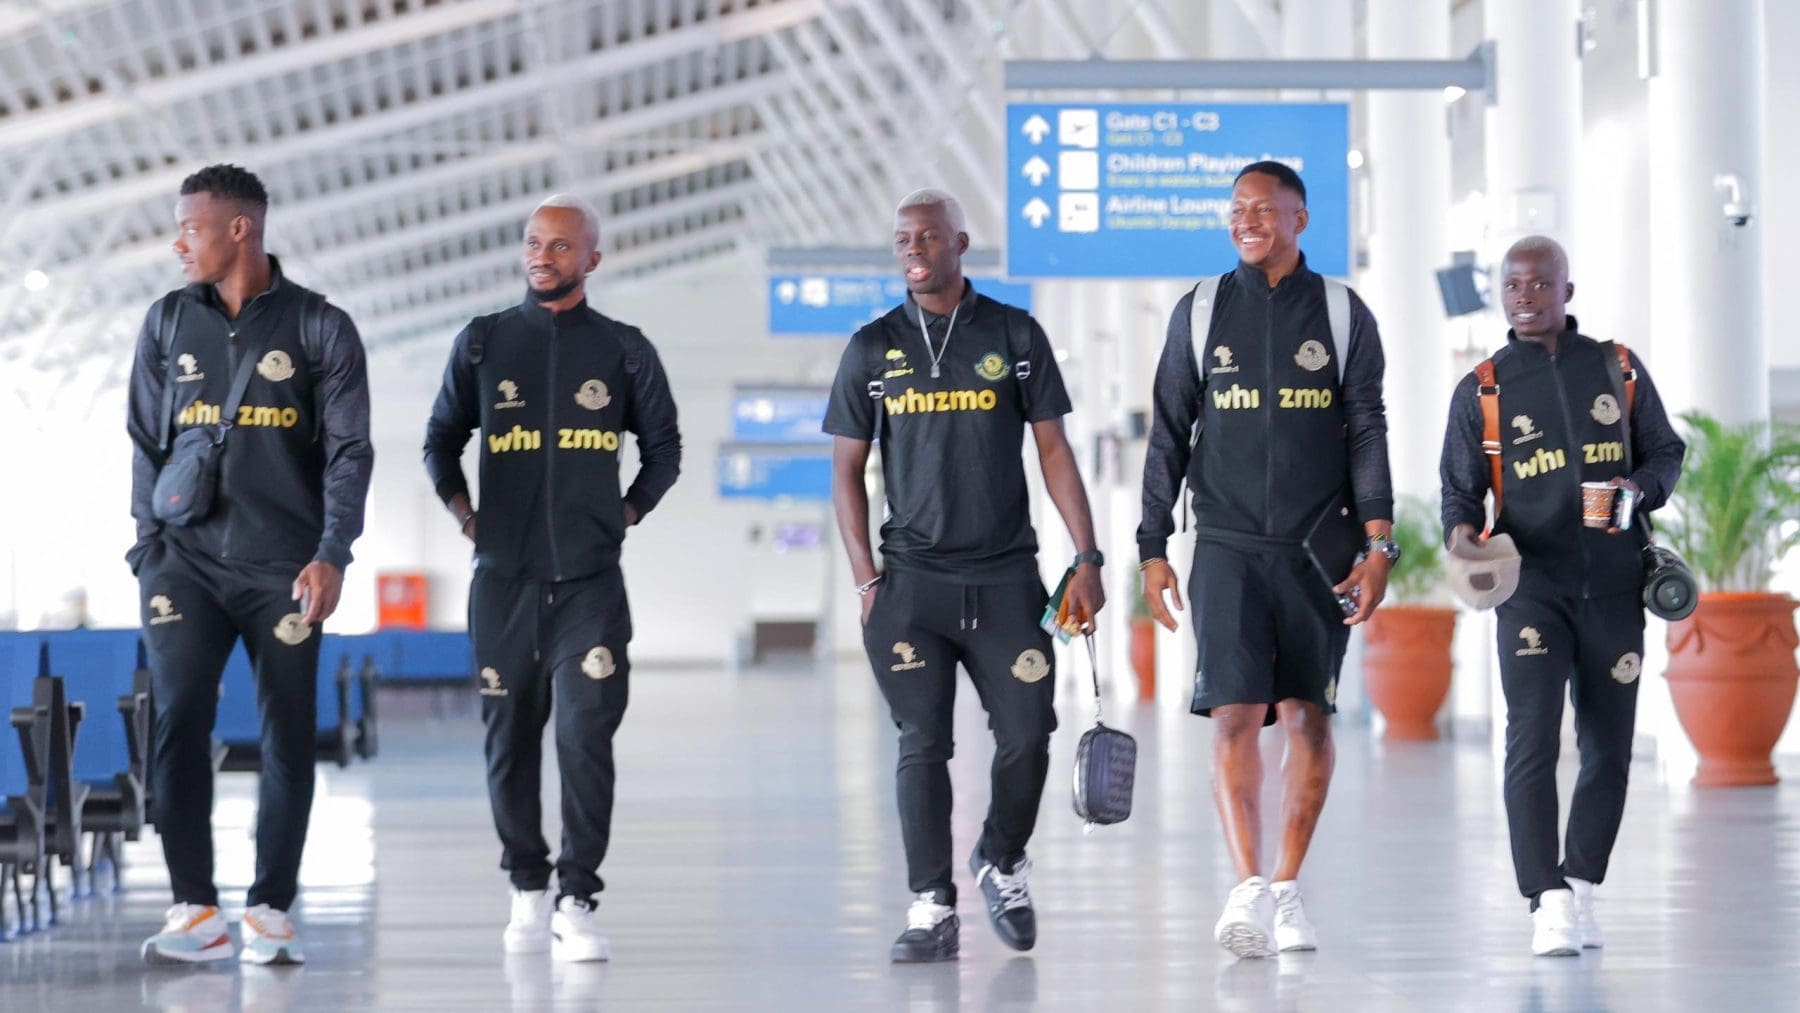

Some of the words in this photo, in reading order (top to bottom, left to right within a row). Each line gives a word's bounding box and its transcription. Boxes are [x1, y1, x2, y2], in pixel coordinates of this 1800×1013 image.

[1105, 112, 1151, 131] Gate
[1153, 112, 1178, 132] C1
[1107, 153, 1185, 172] Children
[1106, 195, 1167, 214] Airline
[1170, 195, 1232, 218] Loung
[884, 387, 997, 416] whizmo
[1278, 387, 1332, 409] zmo
[238, 405, 298, 428] zmo
[558, 428, 619, 451] zmo
[1582, 441, 1624, 464] zm
